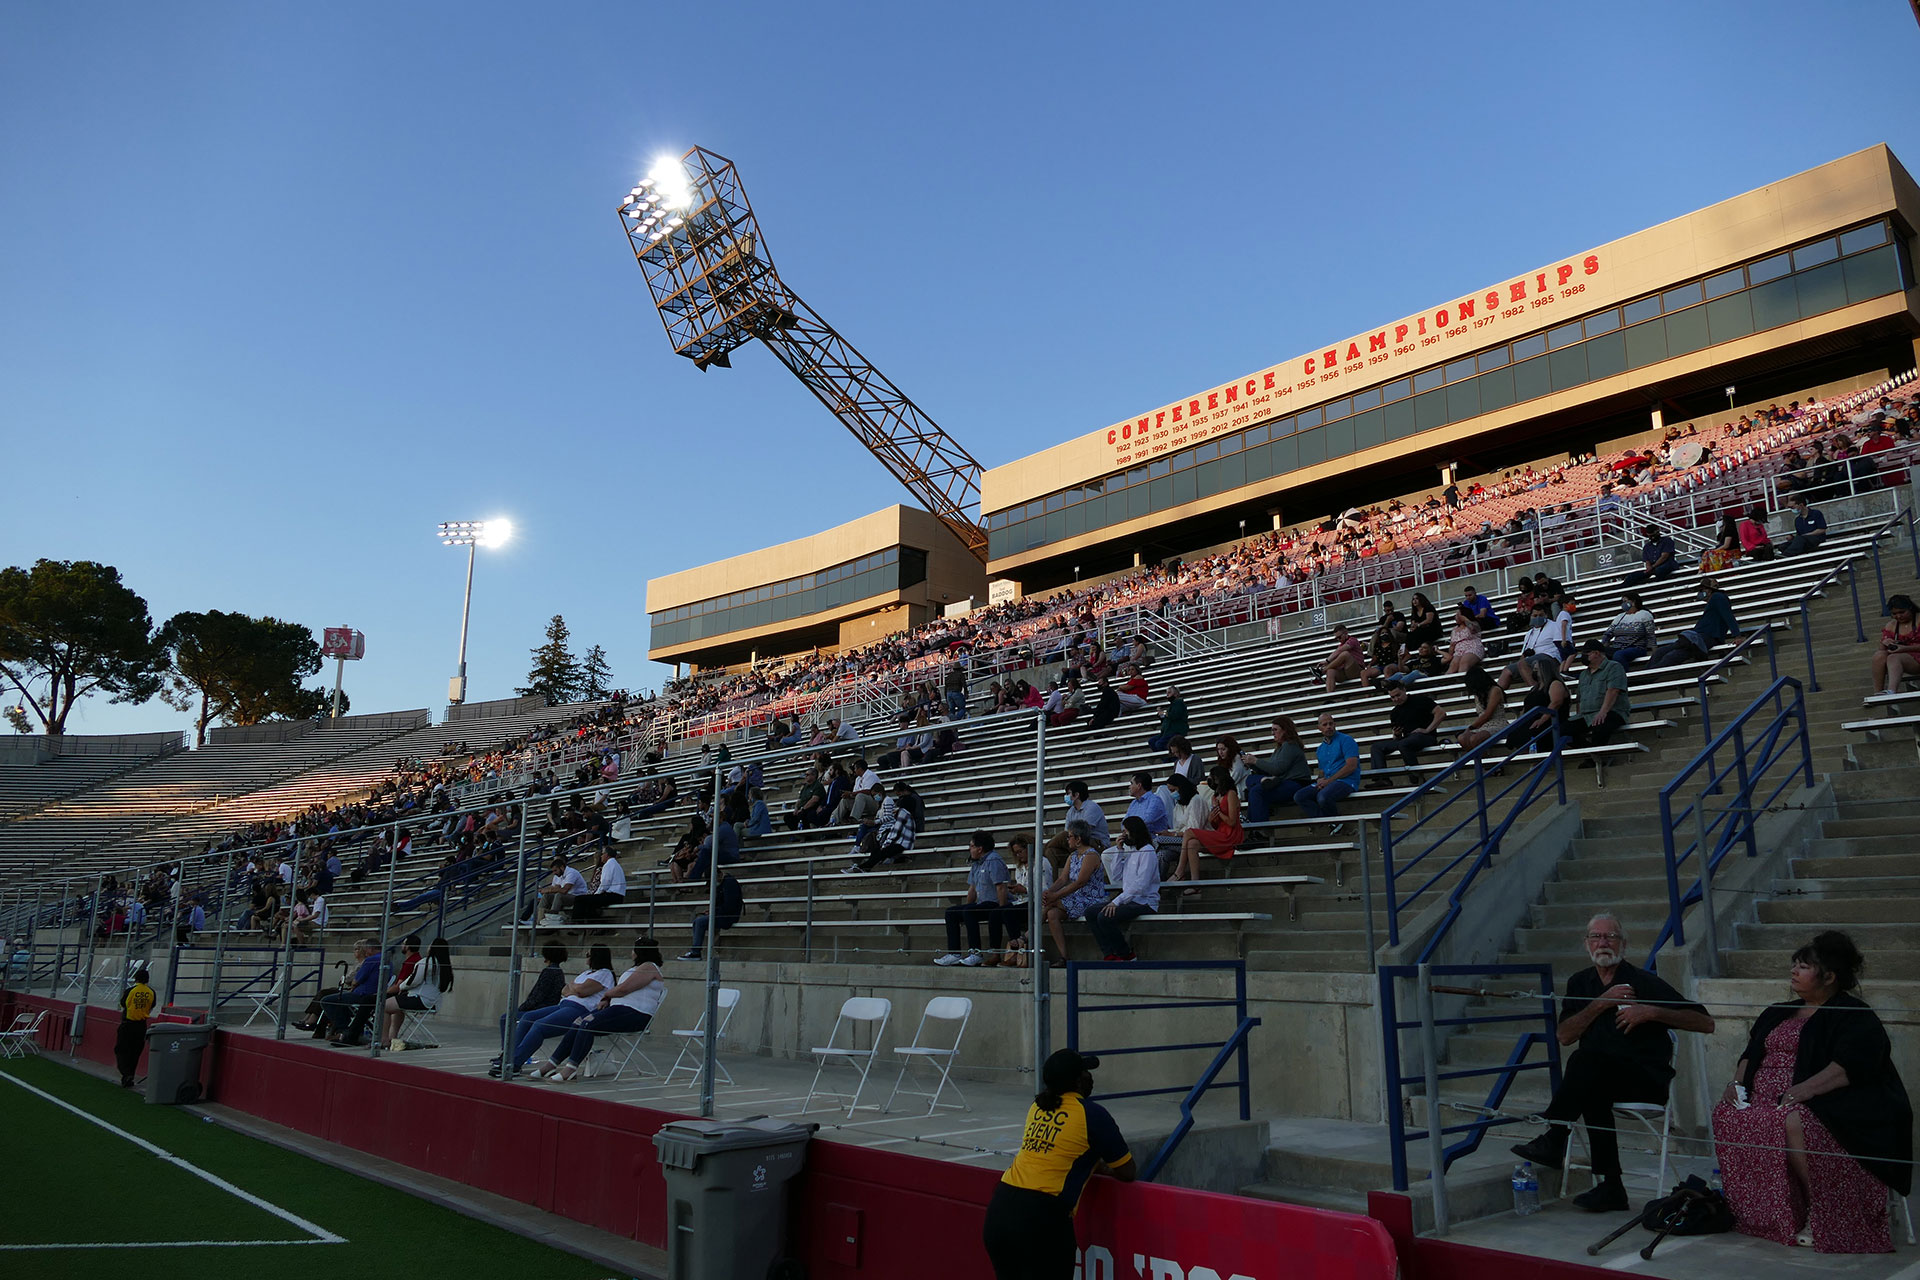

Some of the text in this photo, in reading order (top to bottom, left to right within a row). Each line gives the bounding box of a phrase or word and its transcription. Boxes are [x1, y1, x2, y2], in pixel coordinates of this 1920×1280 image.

[1107, 254, 1599, 445] CONFERENCE CHAMPIONSHIPS
[1116, 284, 1586, 453] 1922 1923 1930 1934 1935 1937 1941 1942 1954 1955 1956 1958 1959 1960 1961 1968 1977 1982 1985 1988
[1116, 407, 1272, 466] 1989 1991 1992 1993 1999 2012 2013 2018
[1599, 553, 1612, 564] 32
[1313, 613, 1324, 622] 32
[1034, 1108, 1068, 1126] CSC
[1026, 1122, 1062, 1142] EVENT
